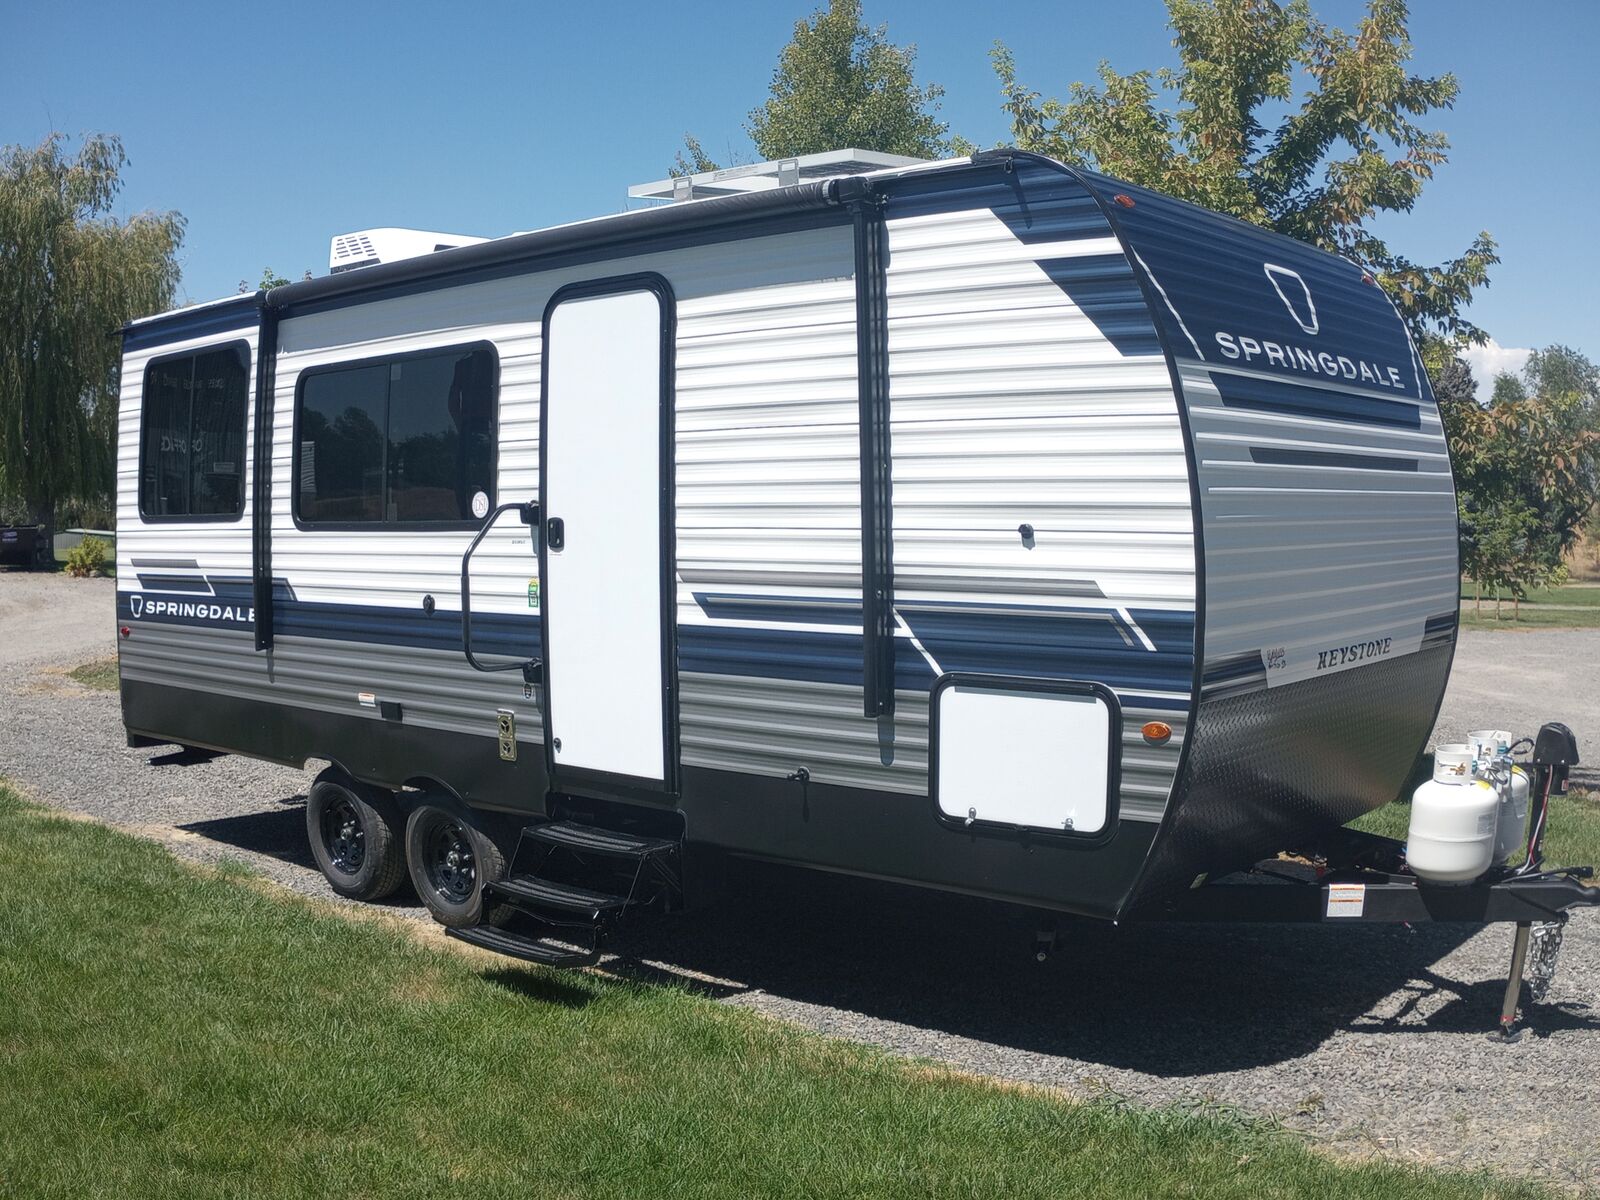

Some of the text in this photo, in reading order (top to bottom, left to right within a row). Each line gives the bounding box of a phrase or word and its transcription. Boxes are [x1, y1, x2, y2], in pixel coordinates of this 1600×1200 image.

[1215, 331, 1406, 389] SPRINGDALE
[145, 601, 256, 622] SPRINGDALE
[1316, 637, 1393, 670] KEYSTONE
